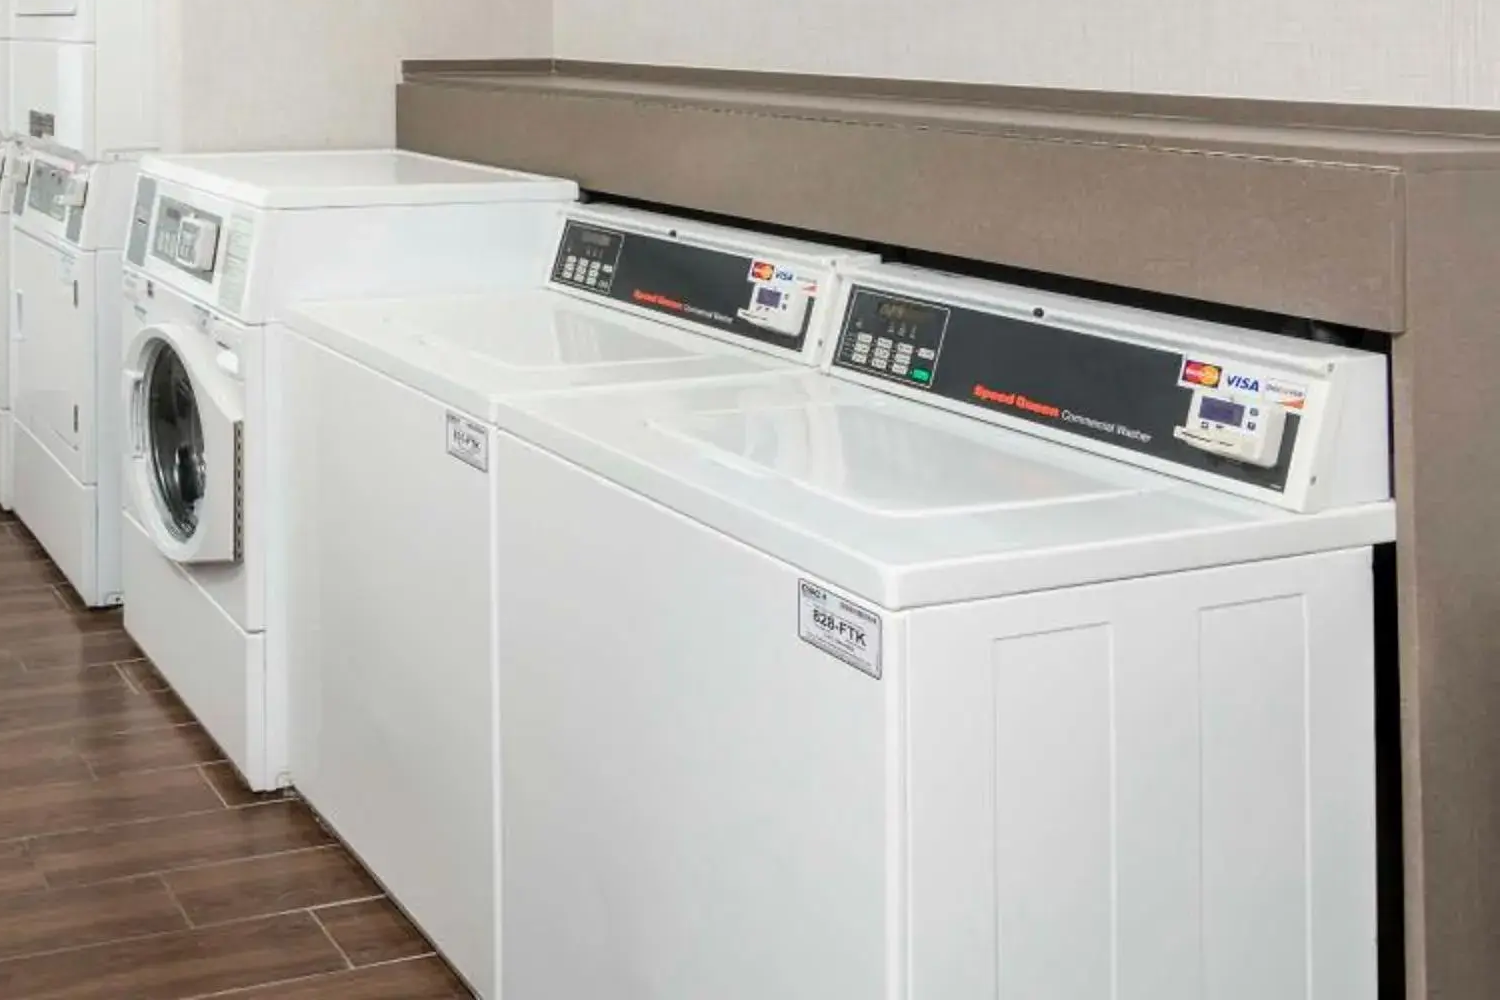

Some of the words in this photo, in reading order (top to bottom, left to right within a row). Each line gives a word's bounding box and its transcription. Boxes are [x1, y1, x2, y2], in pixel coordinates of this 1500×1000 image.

[1227, 374, 1260, 393] VISA
[974, 384, 1015, 405] Speed
[1015, 395, 1061, 418] Queen
[1061, 409, 1115, 433] Commercial
[1116, 423, 1153, 444] Washer
